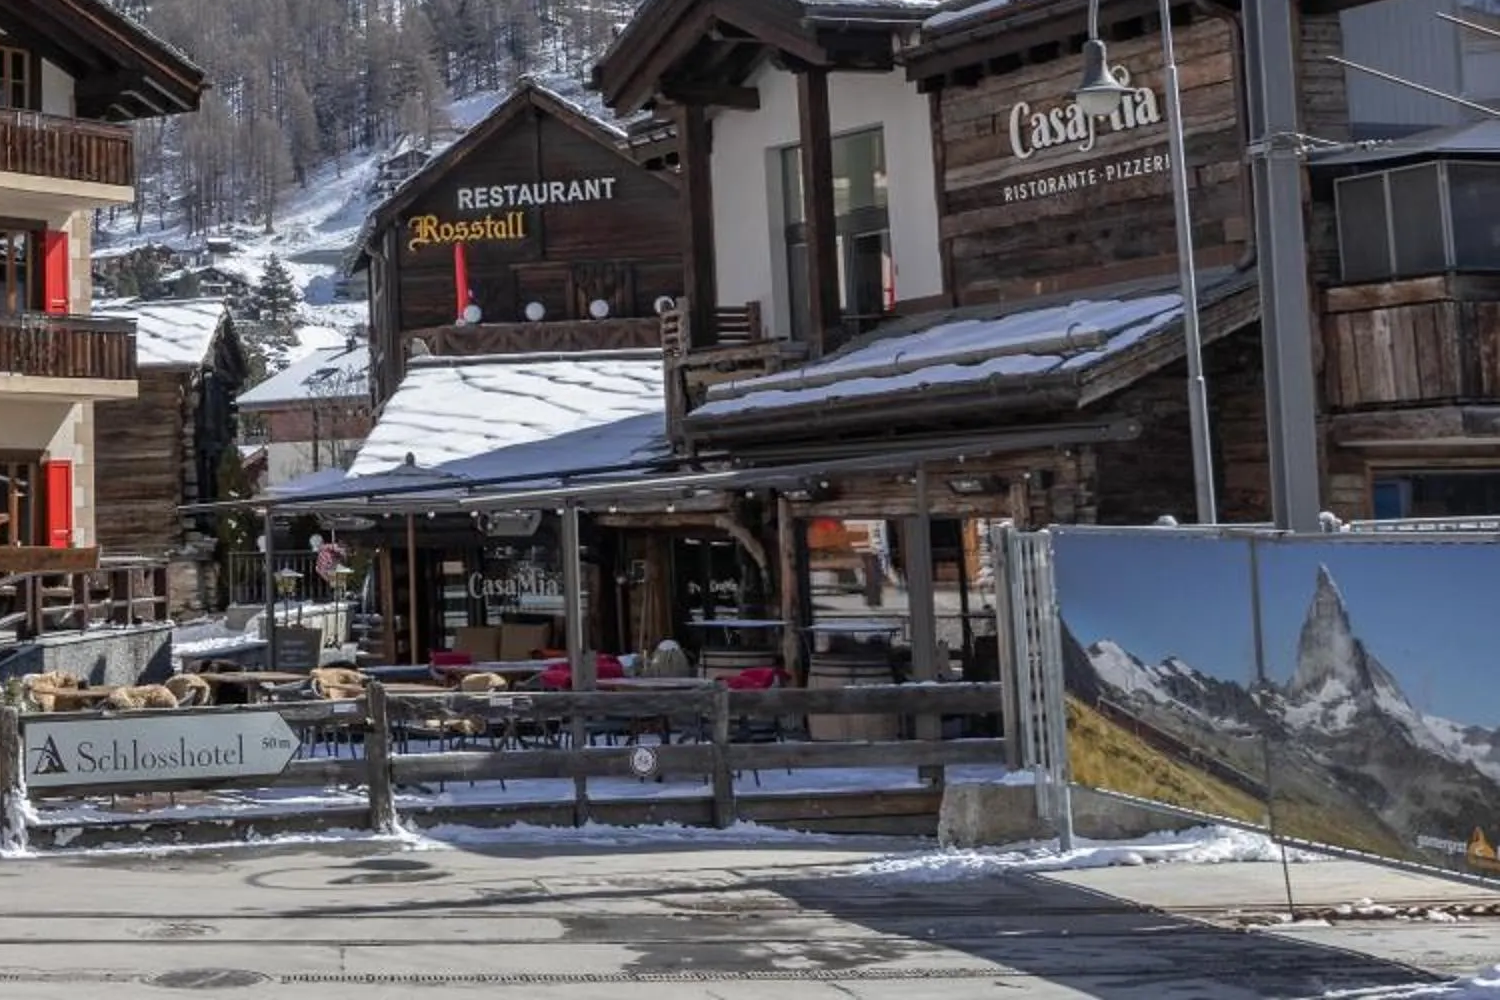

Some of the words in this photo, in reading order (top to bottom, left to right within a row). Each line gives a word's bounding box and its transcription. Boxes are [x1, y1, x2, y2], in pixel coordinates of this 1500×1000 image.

[1106, 153, 1171, 182] PIZZERI
[457, 177, 616, 210] RESTAURANT
[408, 211, 526, 251] Rosstall
[76, 734, 244, 774] Schlosshotel
